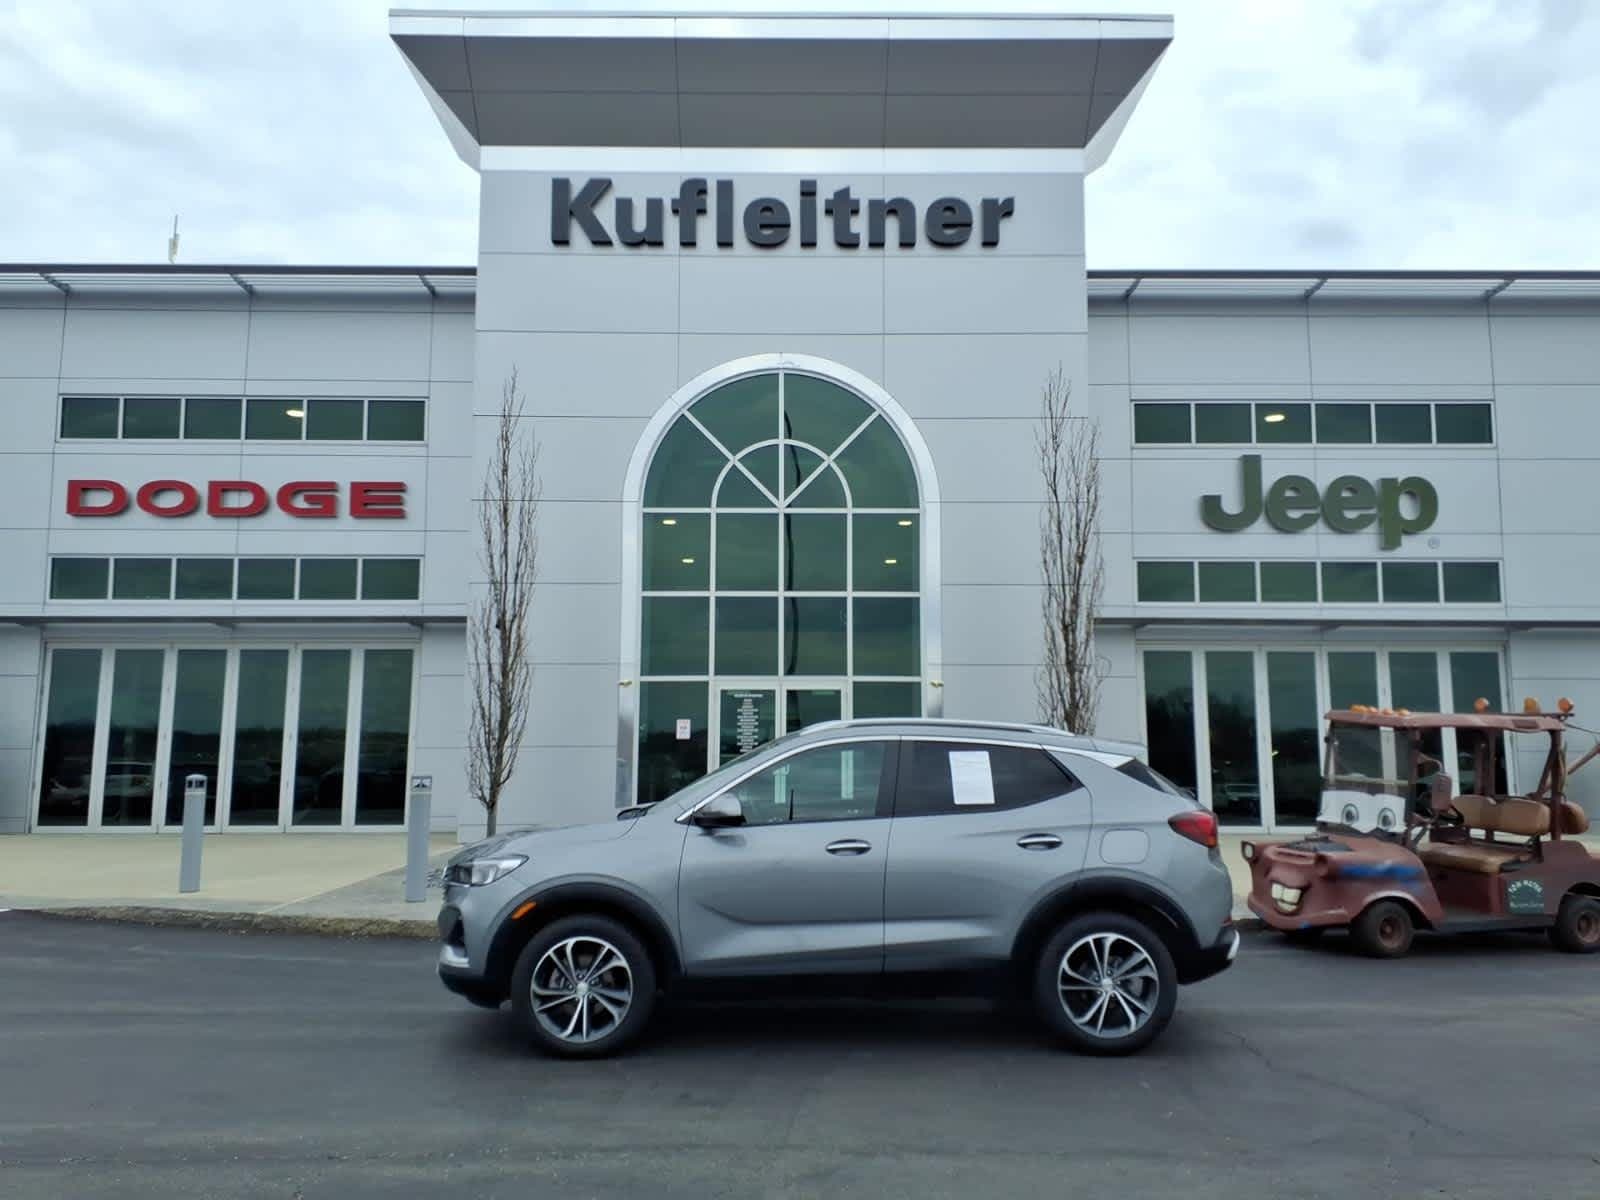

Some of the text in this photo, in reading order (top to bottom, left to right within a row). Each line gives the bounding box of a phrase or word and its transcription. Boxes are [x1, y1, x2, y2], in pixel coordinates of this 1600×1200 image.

[551, 177, 1016, 248] Kufleitner
[66, 479, 408, 519] DODGE
[1201, 454, 1439, 551] Jeep
